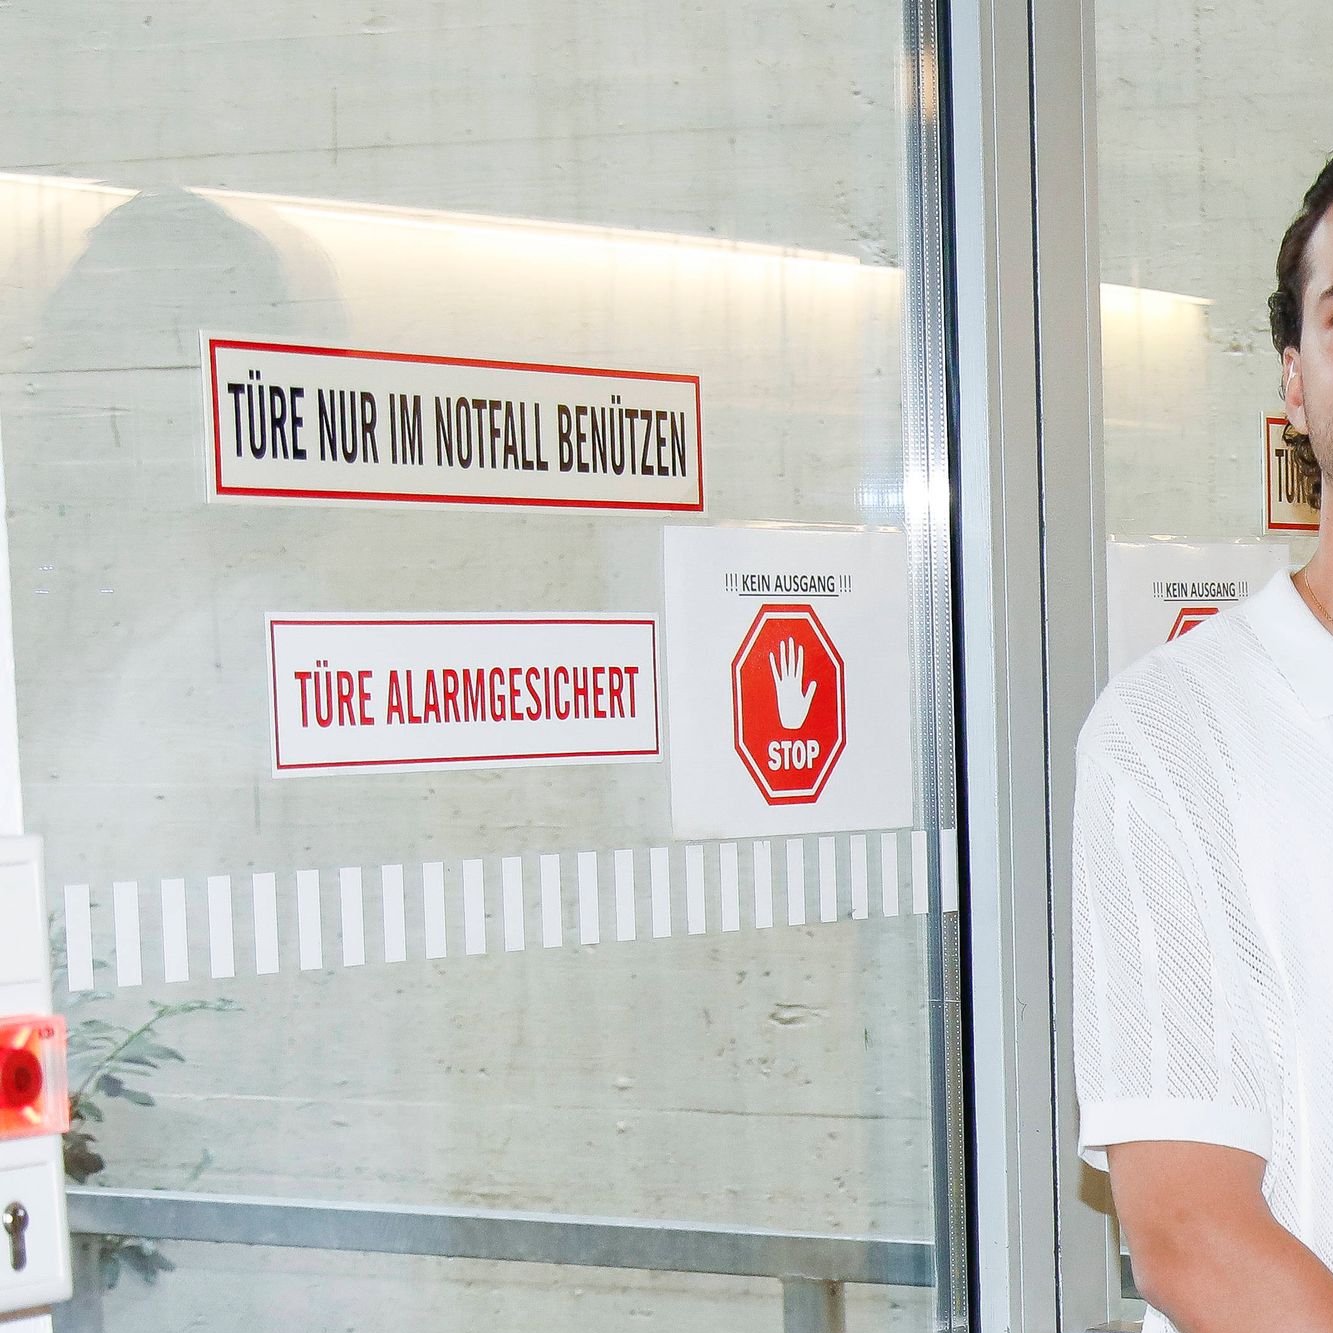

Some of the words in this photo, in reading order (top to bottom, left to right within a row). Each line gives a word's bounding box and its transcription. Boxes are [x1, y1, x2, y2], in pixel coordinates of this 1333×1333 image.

[227, 369, 307, 461] TÜRE
[316, 388, 379, 464] NUR
[389, 393, 424, 466] IM
[435, 396, 549, 472] NOTFALL
[557, 395, 687, 477] BENÜTZEN
[741, 574, 771, 592] KEIN
[774, 574, 836, 593] AUSGANG
[1165, 582, 1188, 598] KEIN
[1190, 582, 1236, 598] AUSGANG
[294, 660, 375, 728] TÜRE
[386, 666, 640, 725] ALARMGESICHERT
[767, 739, 820, 771] STOP
